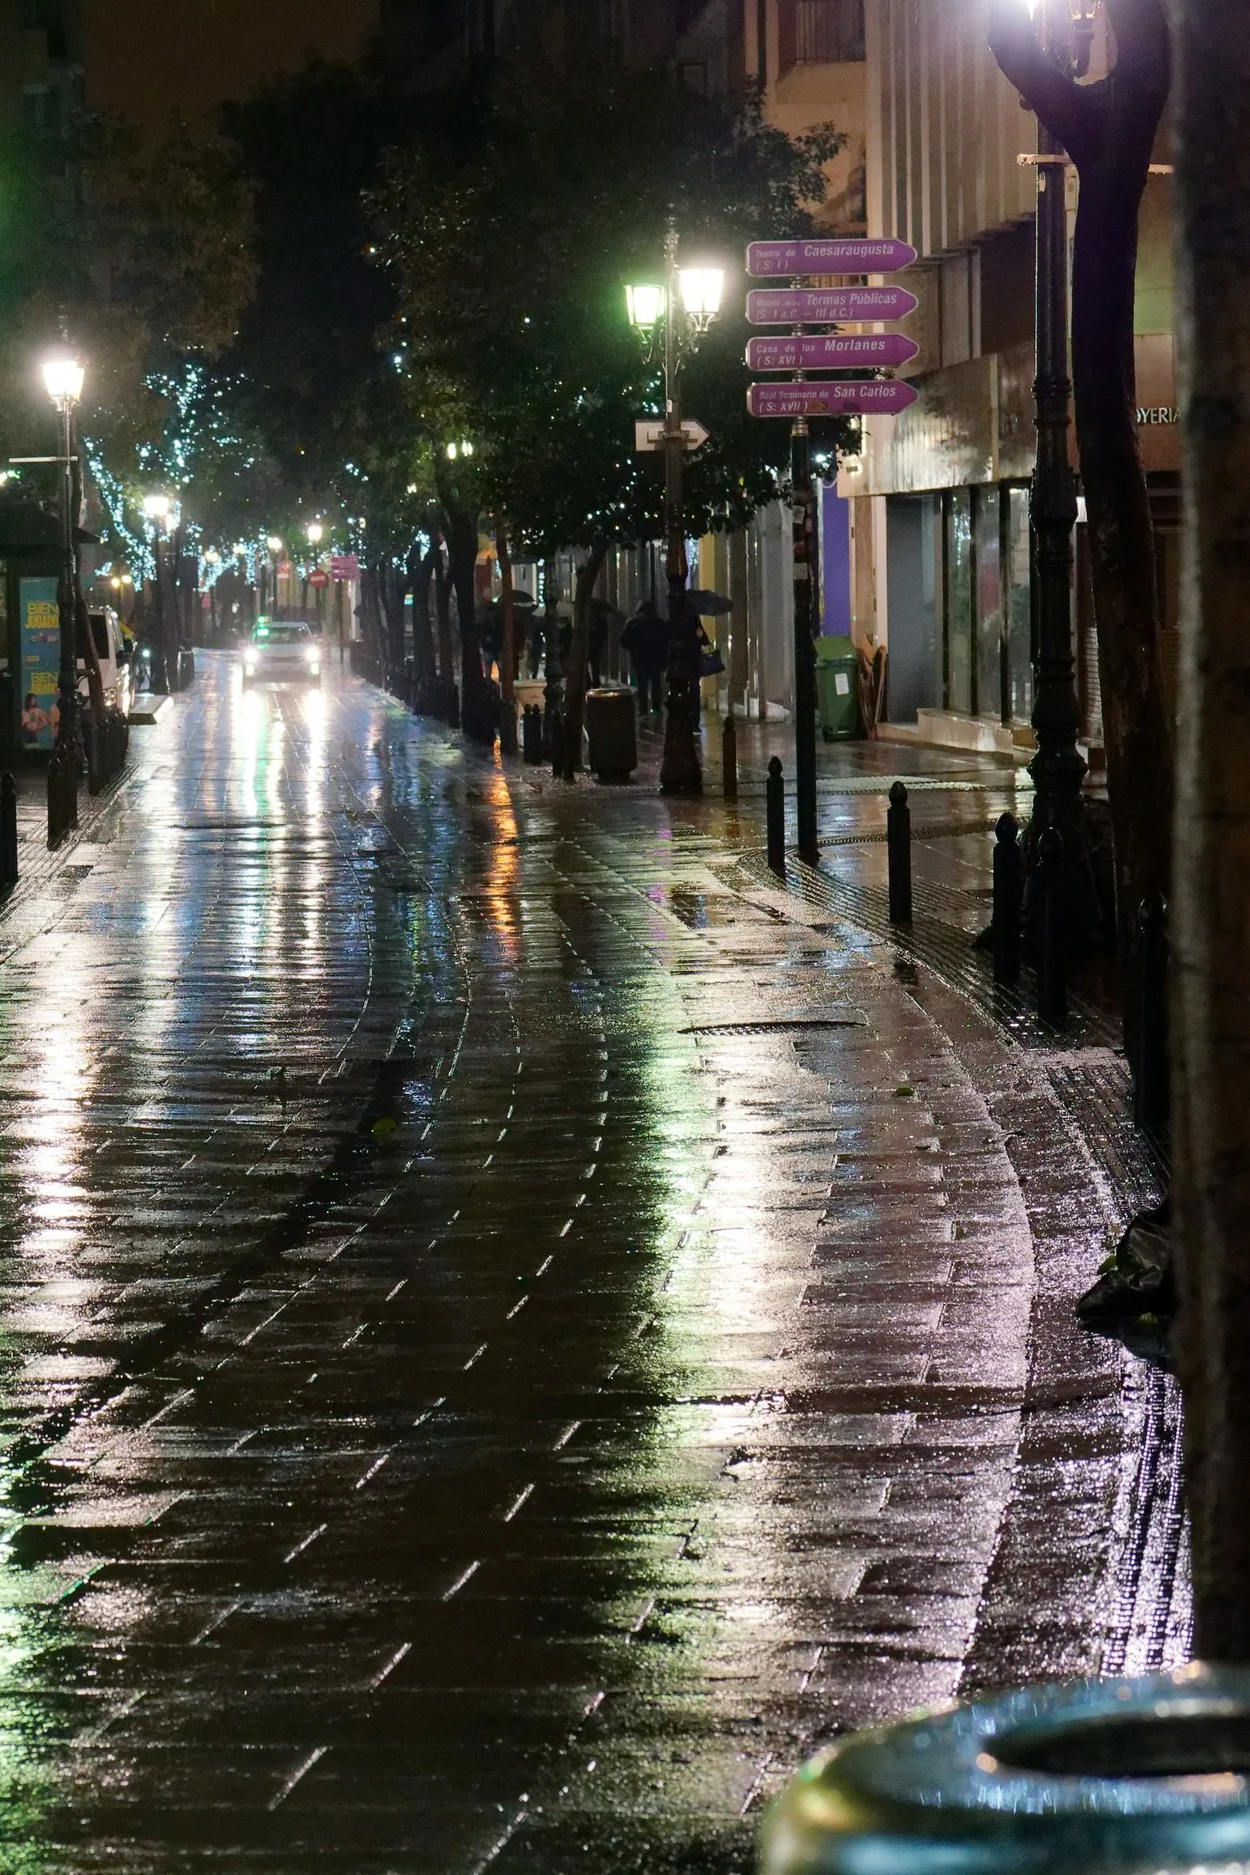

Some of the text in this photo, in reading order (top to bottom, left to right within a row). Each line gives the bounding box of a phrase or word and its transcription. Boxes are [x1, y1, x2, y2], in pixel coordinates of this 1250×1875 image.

[756, 243, 895, 259] Teatro de Caesaraugusta
[806, 294, 846, 305] Termas
[850, 292, 897, 305] Públicas
[757, 339, 886, 354] Casa de los Morlanes
[759, 385, 896, 400] Real Seminario de San Carlos
[28, 602, 59, 615] BIEN
[25, 615, 59, 628] JUGADO
